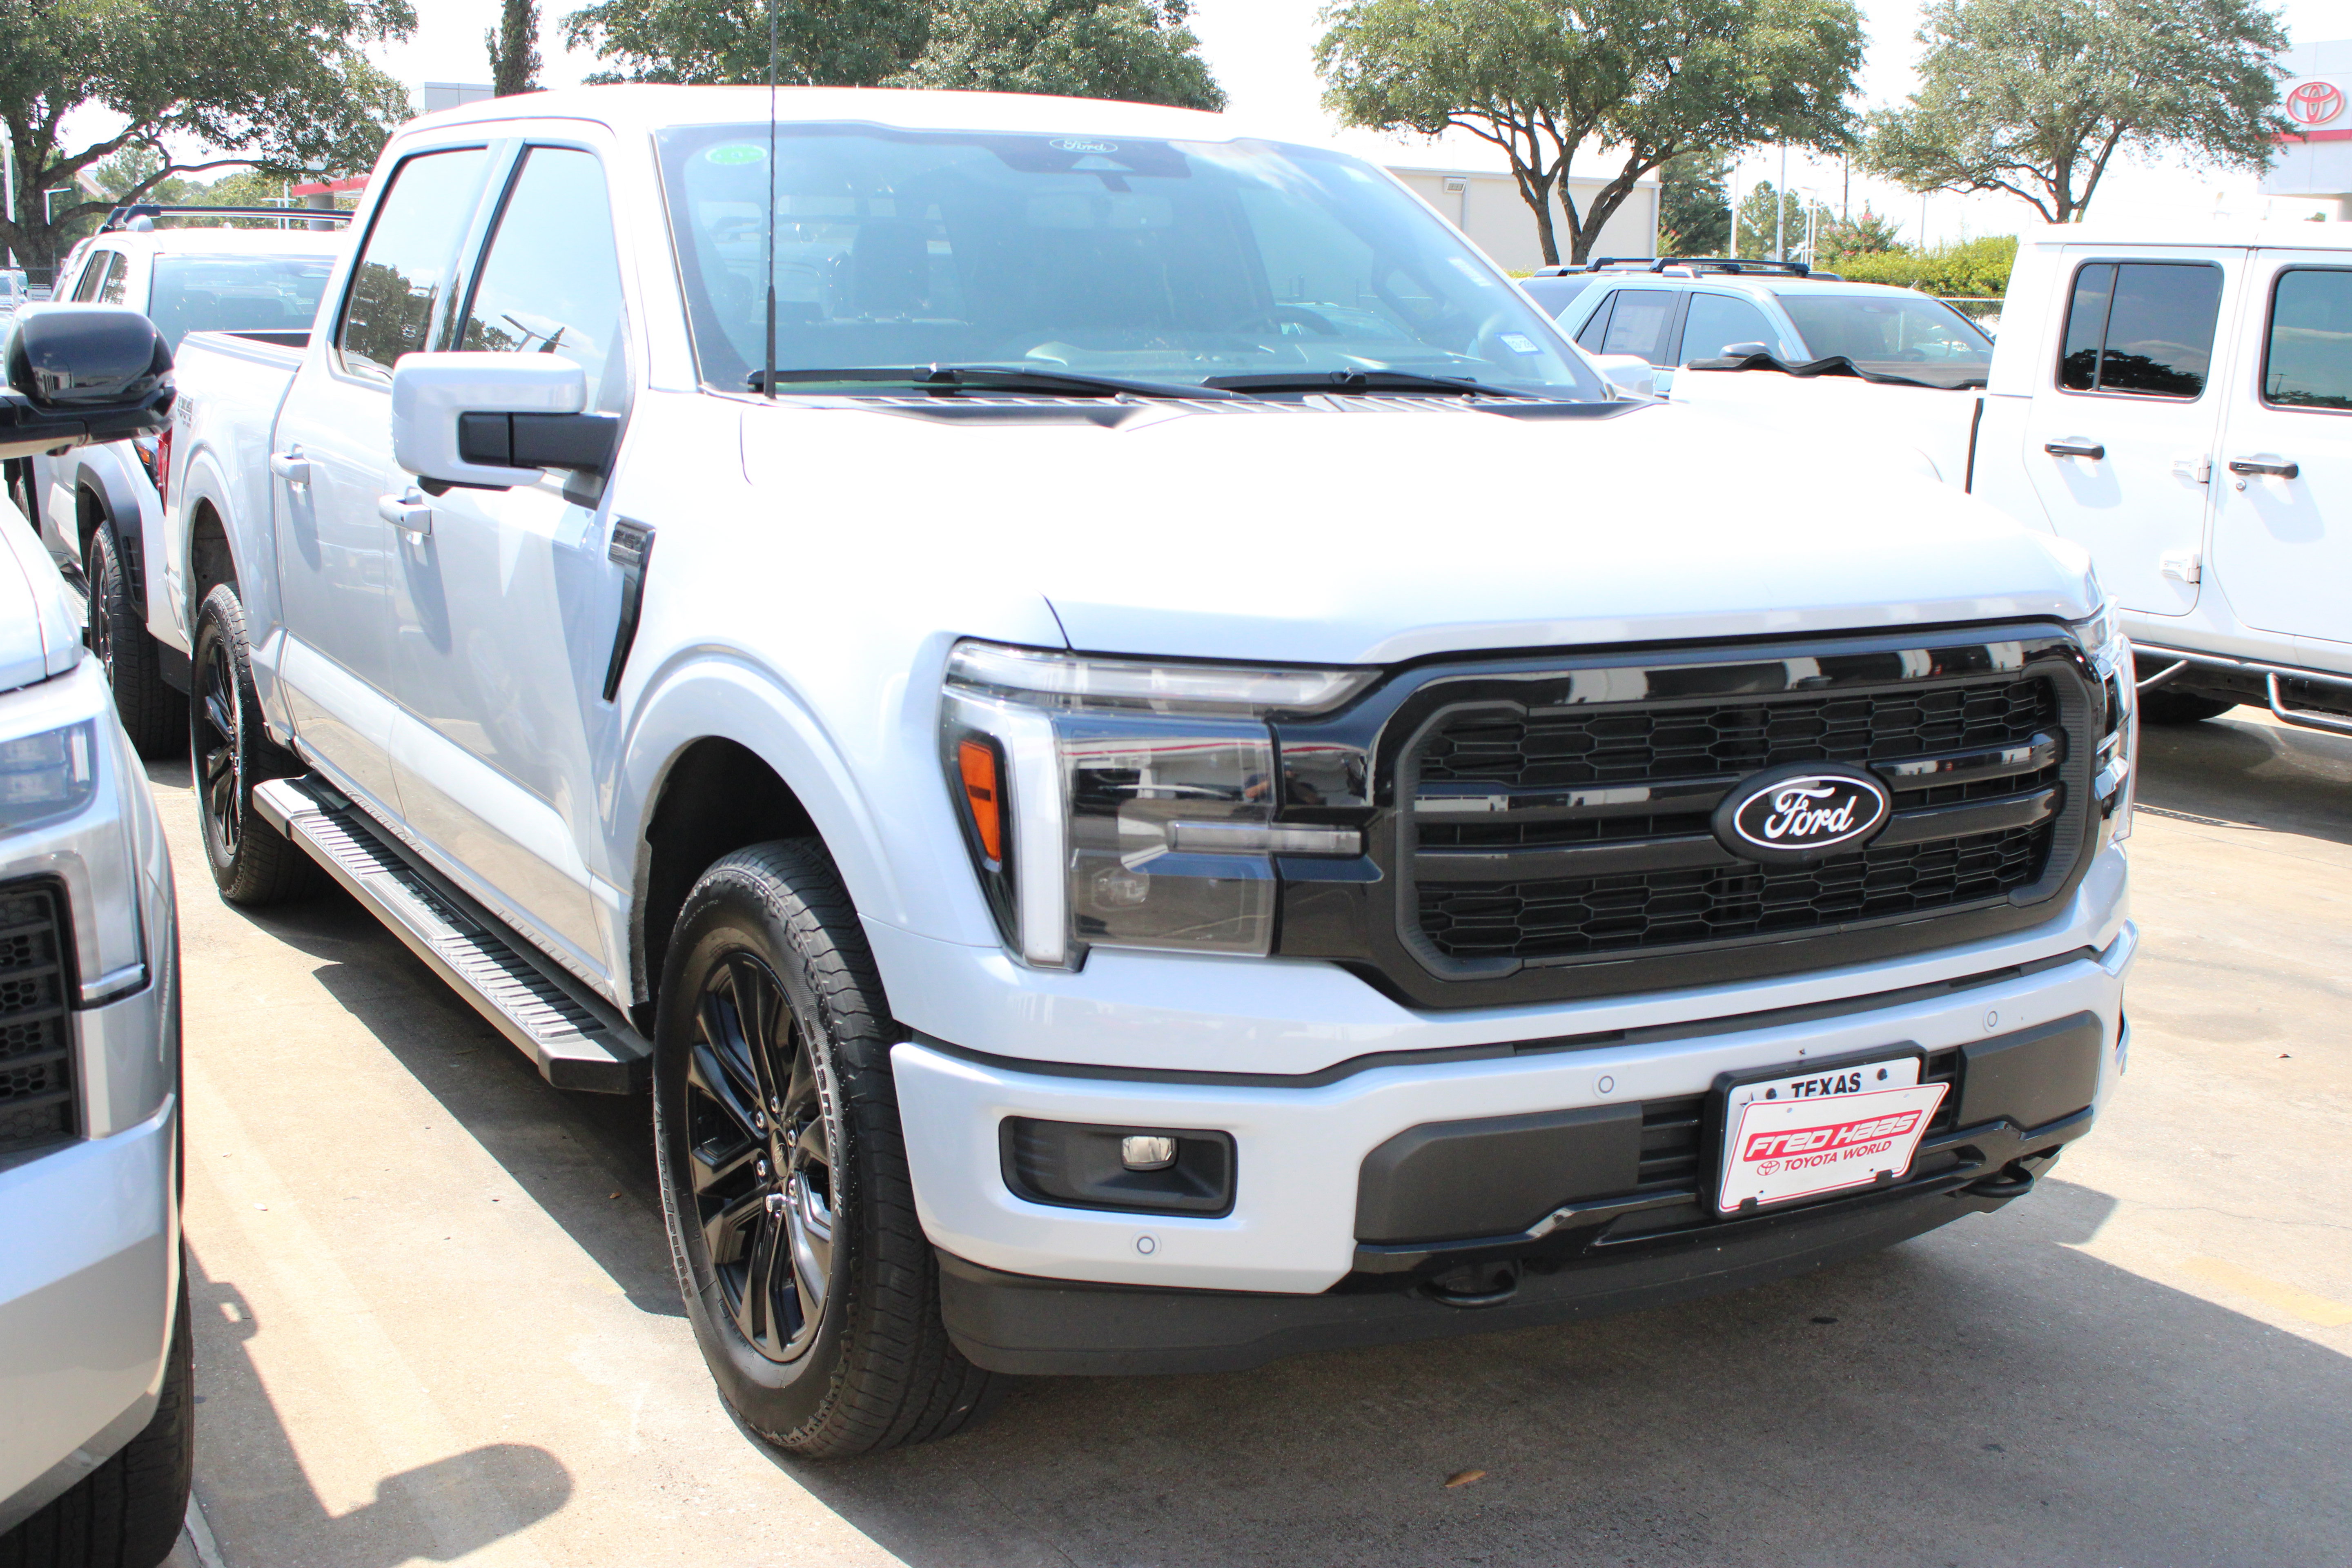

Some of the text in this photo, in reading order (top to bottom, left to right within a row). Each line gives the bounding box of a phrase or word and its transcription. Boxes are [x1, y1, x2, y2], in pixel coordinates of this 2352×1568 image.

[1063, 139, 1107, 151] Ford
[1764, 786, 1859, 839] Ford
[1791, 1072, 1862, 1098] TEXAS
[1784, 1140, 1892, 1172] TOYOTA WORLD
